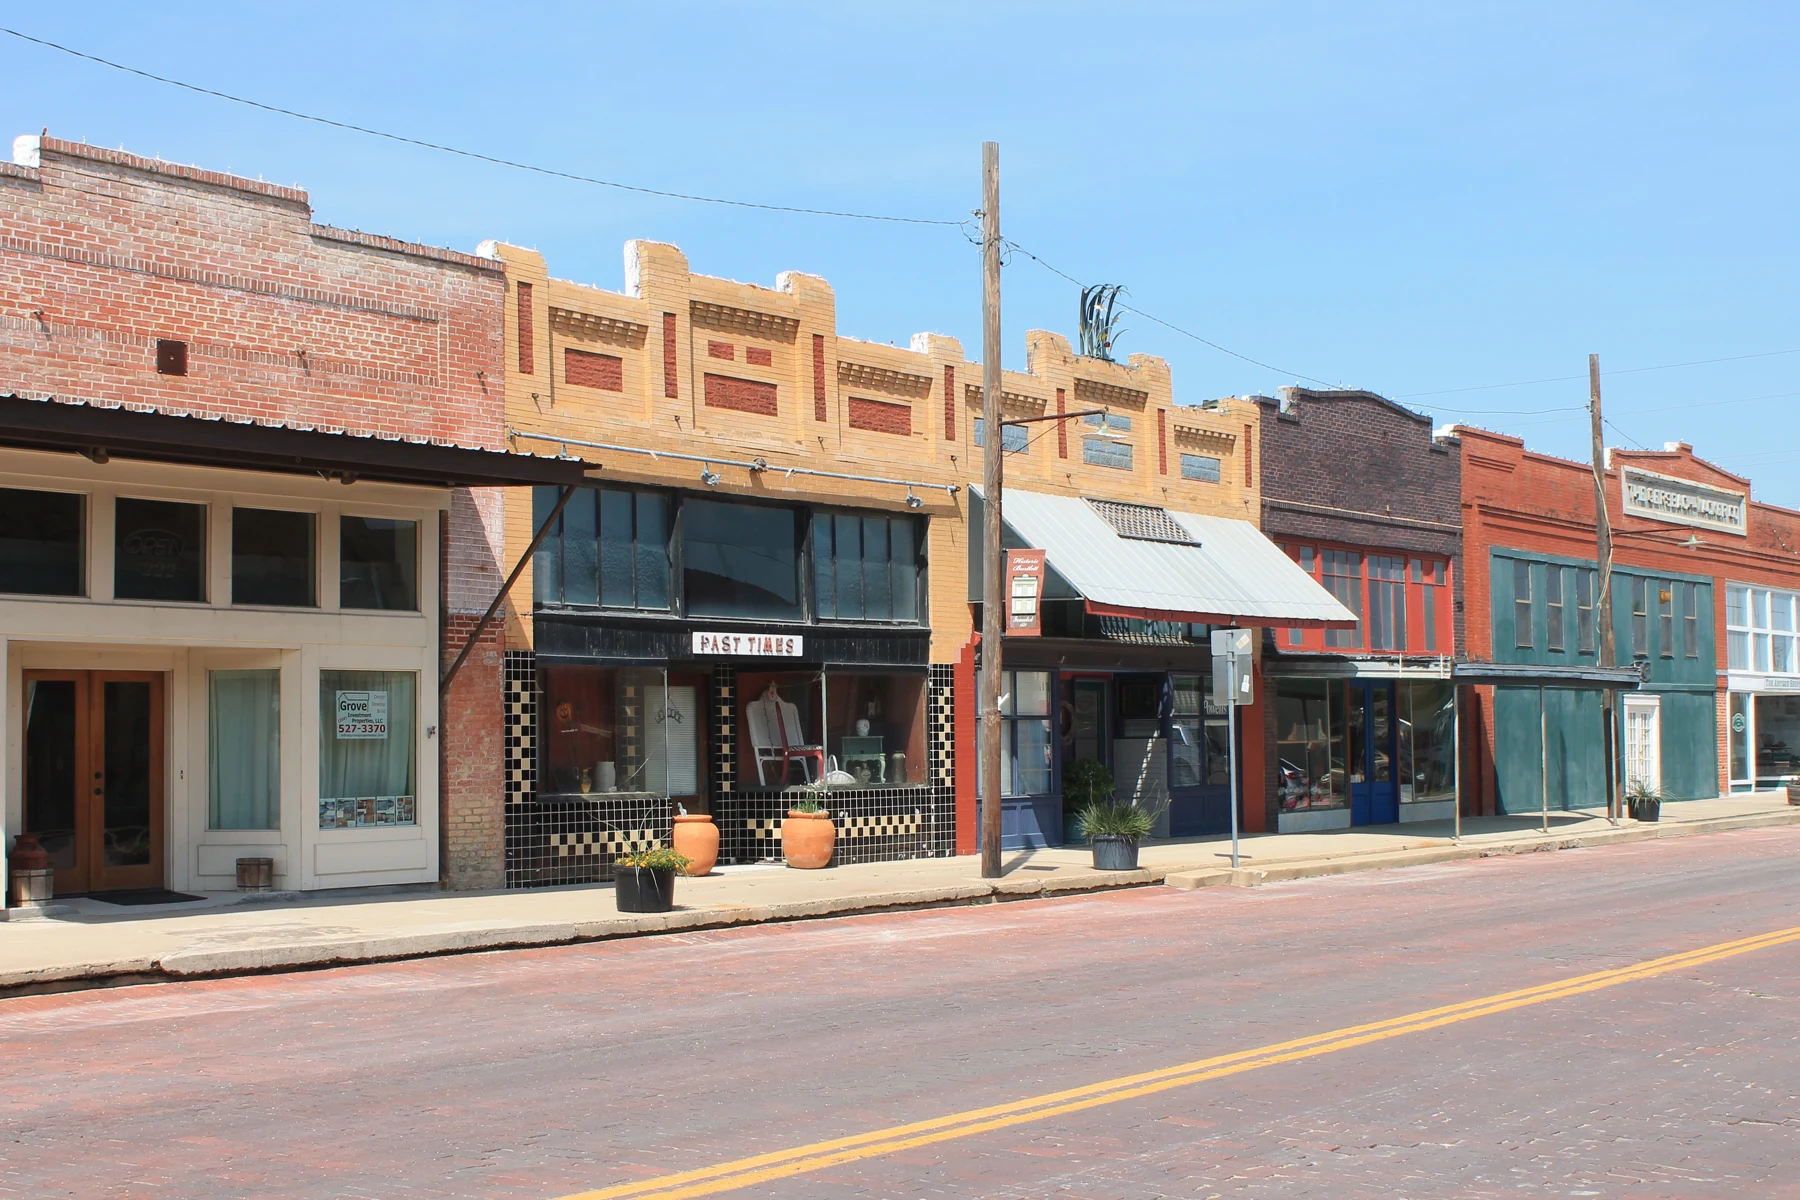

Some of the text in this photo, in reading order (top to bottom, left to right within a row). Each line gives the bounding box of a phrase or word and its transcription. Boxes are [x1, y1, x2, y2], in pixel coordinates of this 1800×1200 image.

[127, 536, 184, 556] OPEN
[700, 634, 794, 654] PAST TIMES
[340, 701, 367, 711] Grove
[338, 724, 386, 733] 527-3370
